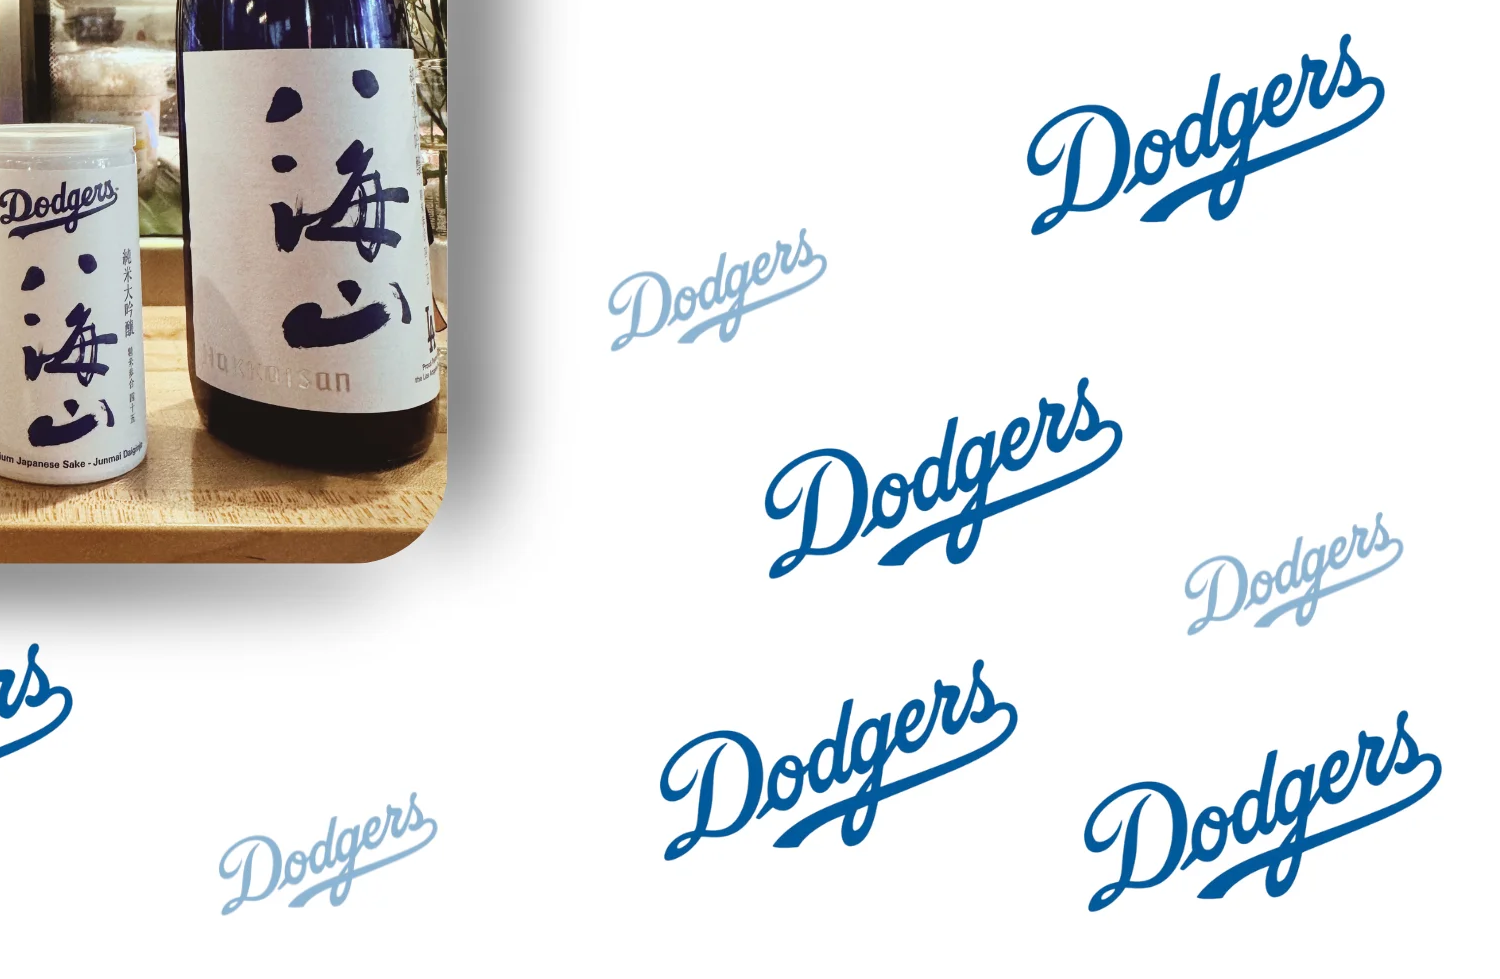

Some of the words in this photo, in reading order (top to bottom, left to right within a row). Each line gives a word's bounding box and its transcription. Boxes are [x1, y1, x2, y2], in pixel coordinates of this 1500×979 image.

[0, 180, 118, 240] Dodgers
[266, 69, 412, 349] 八海山
[21, 253, 118, 447] 八海山
[16, 457, 60, 468] Japanese
[63, 460, 86, 468] Sake
[93, 451, 122, 466] Junmai
